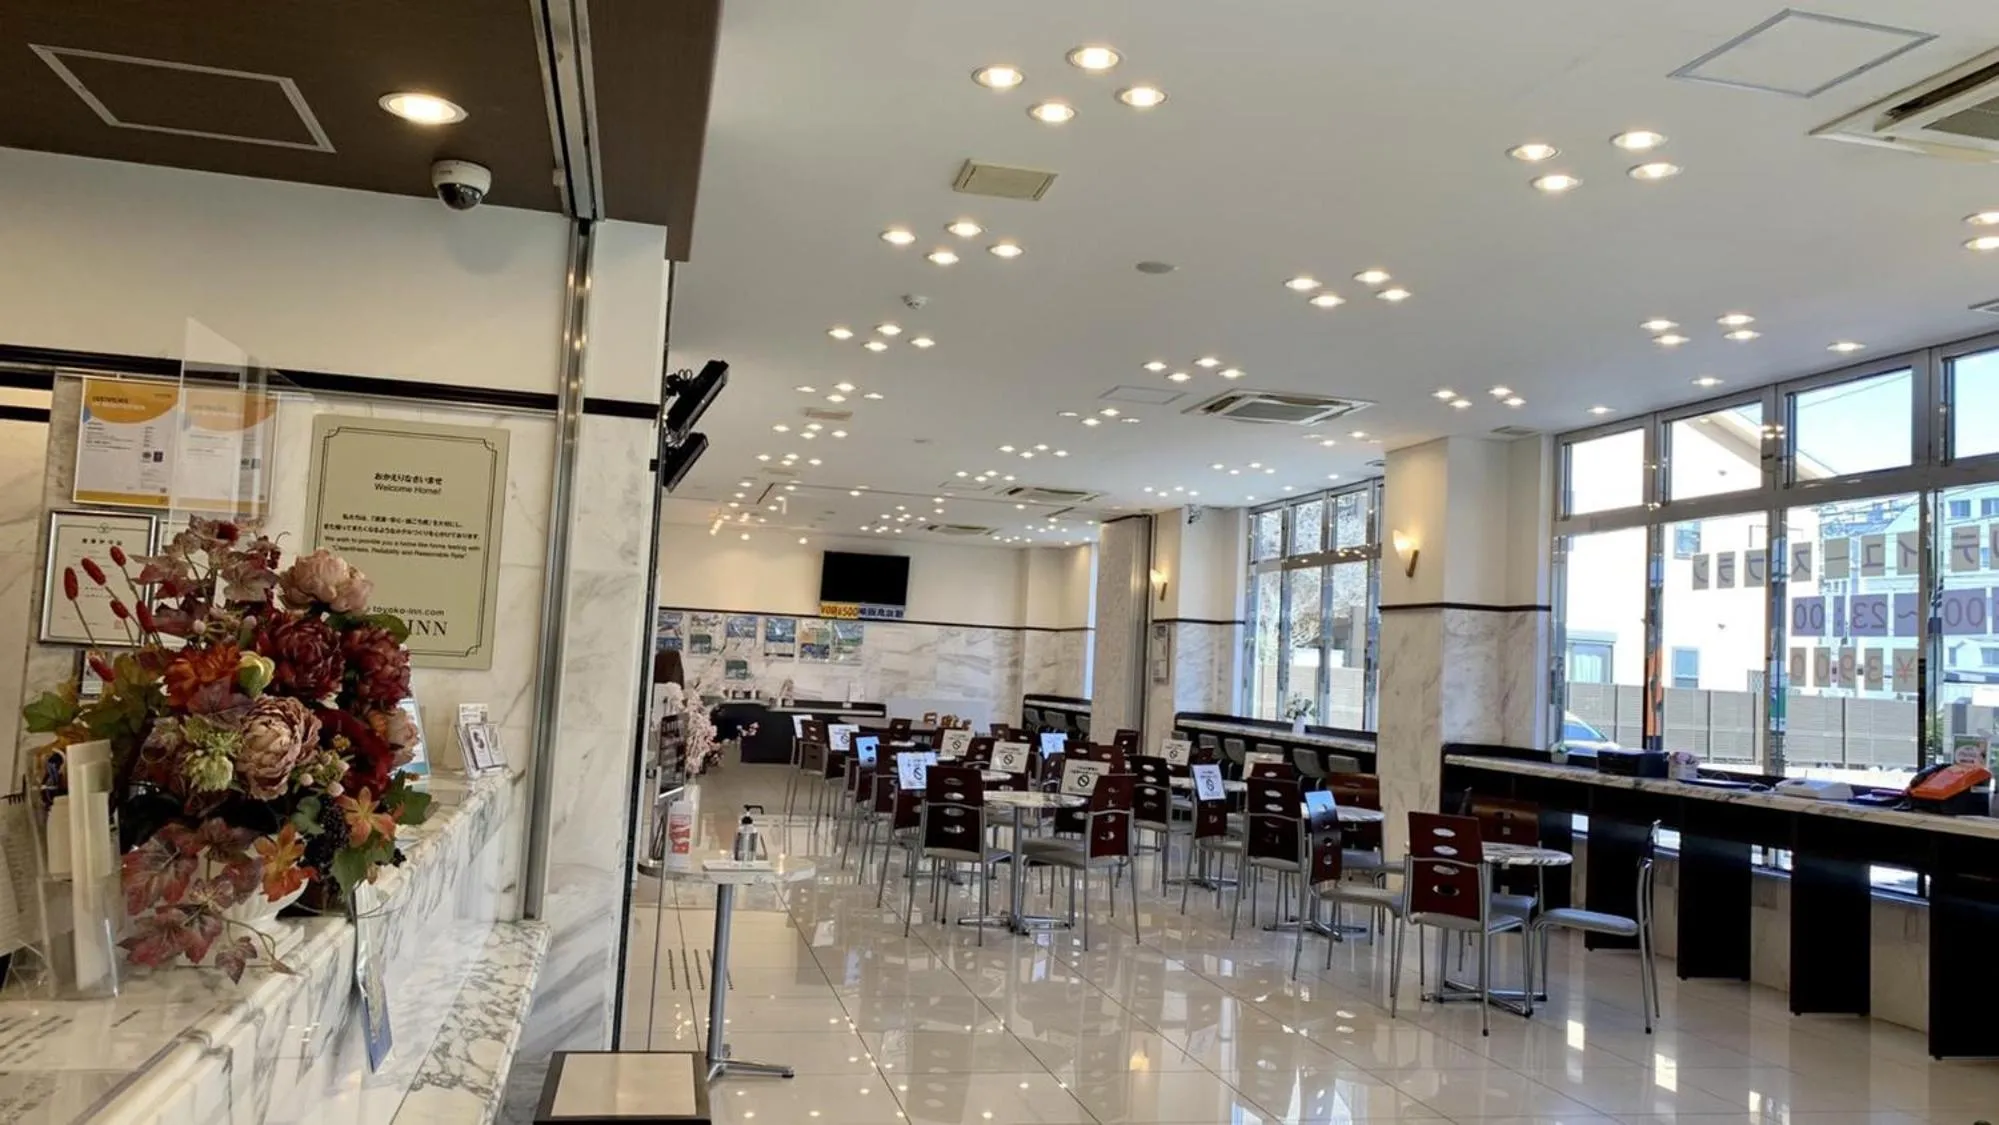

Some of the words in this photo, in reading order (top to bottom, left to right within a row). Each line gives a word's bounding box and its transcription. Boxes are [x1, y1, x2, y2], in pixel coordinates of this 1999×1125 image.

[374, 483, 413, 494] Welcome
[372, 605, 445, 616] toyoko-inn.com
[407, 618, 448, 637] INN
